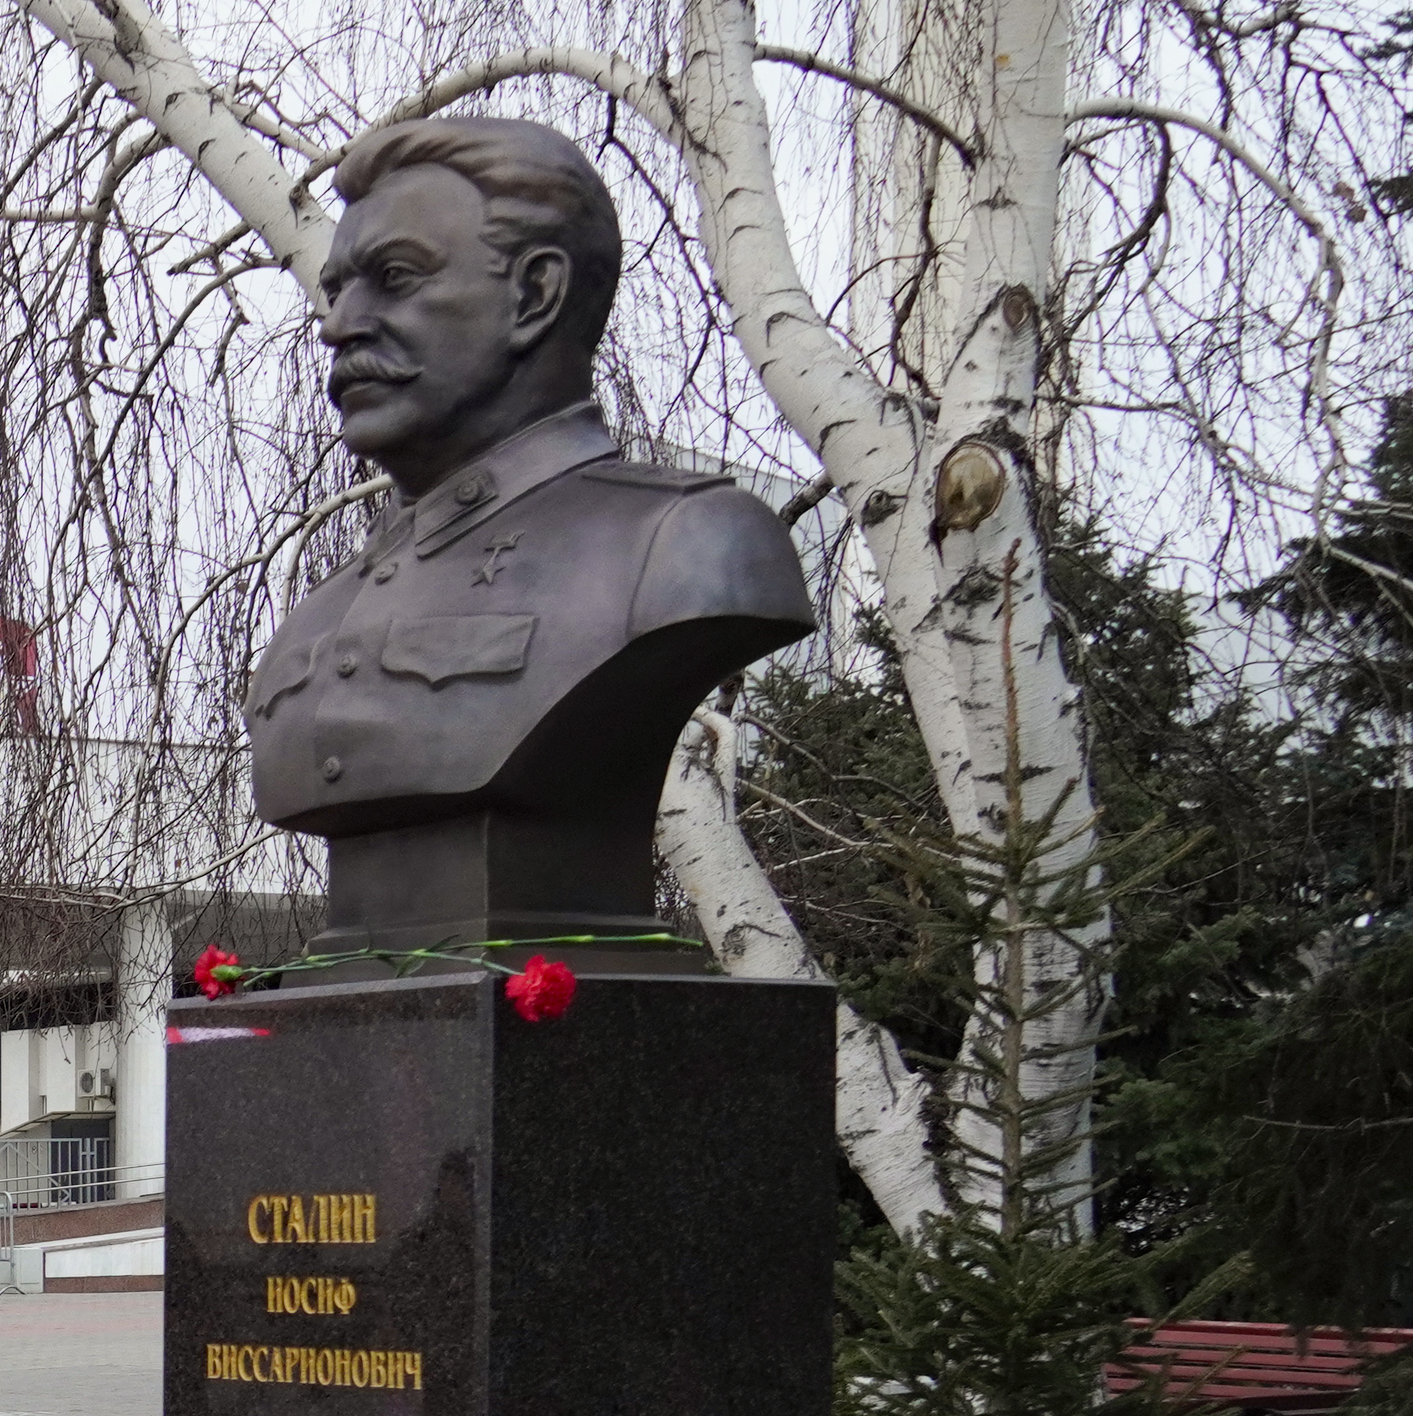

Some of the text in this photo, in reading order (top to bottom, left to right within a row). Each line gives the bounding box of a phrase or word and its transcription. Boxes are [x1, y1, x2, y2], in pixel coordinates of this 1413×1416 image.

[248, 1194, 376, 1244] СТАЛИН
[267, 1276, 357, 1315] ИОСИФ
[207, 1343, 422, 1390] ВИССАРИОНОВИЧ
